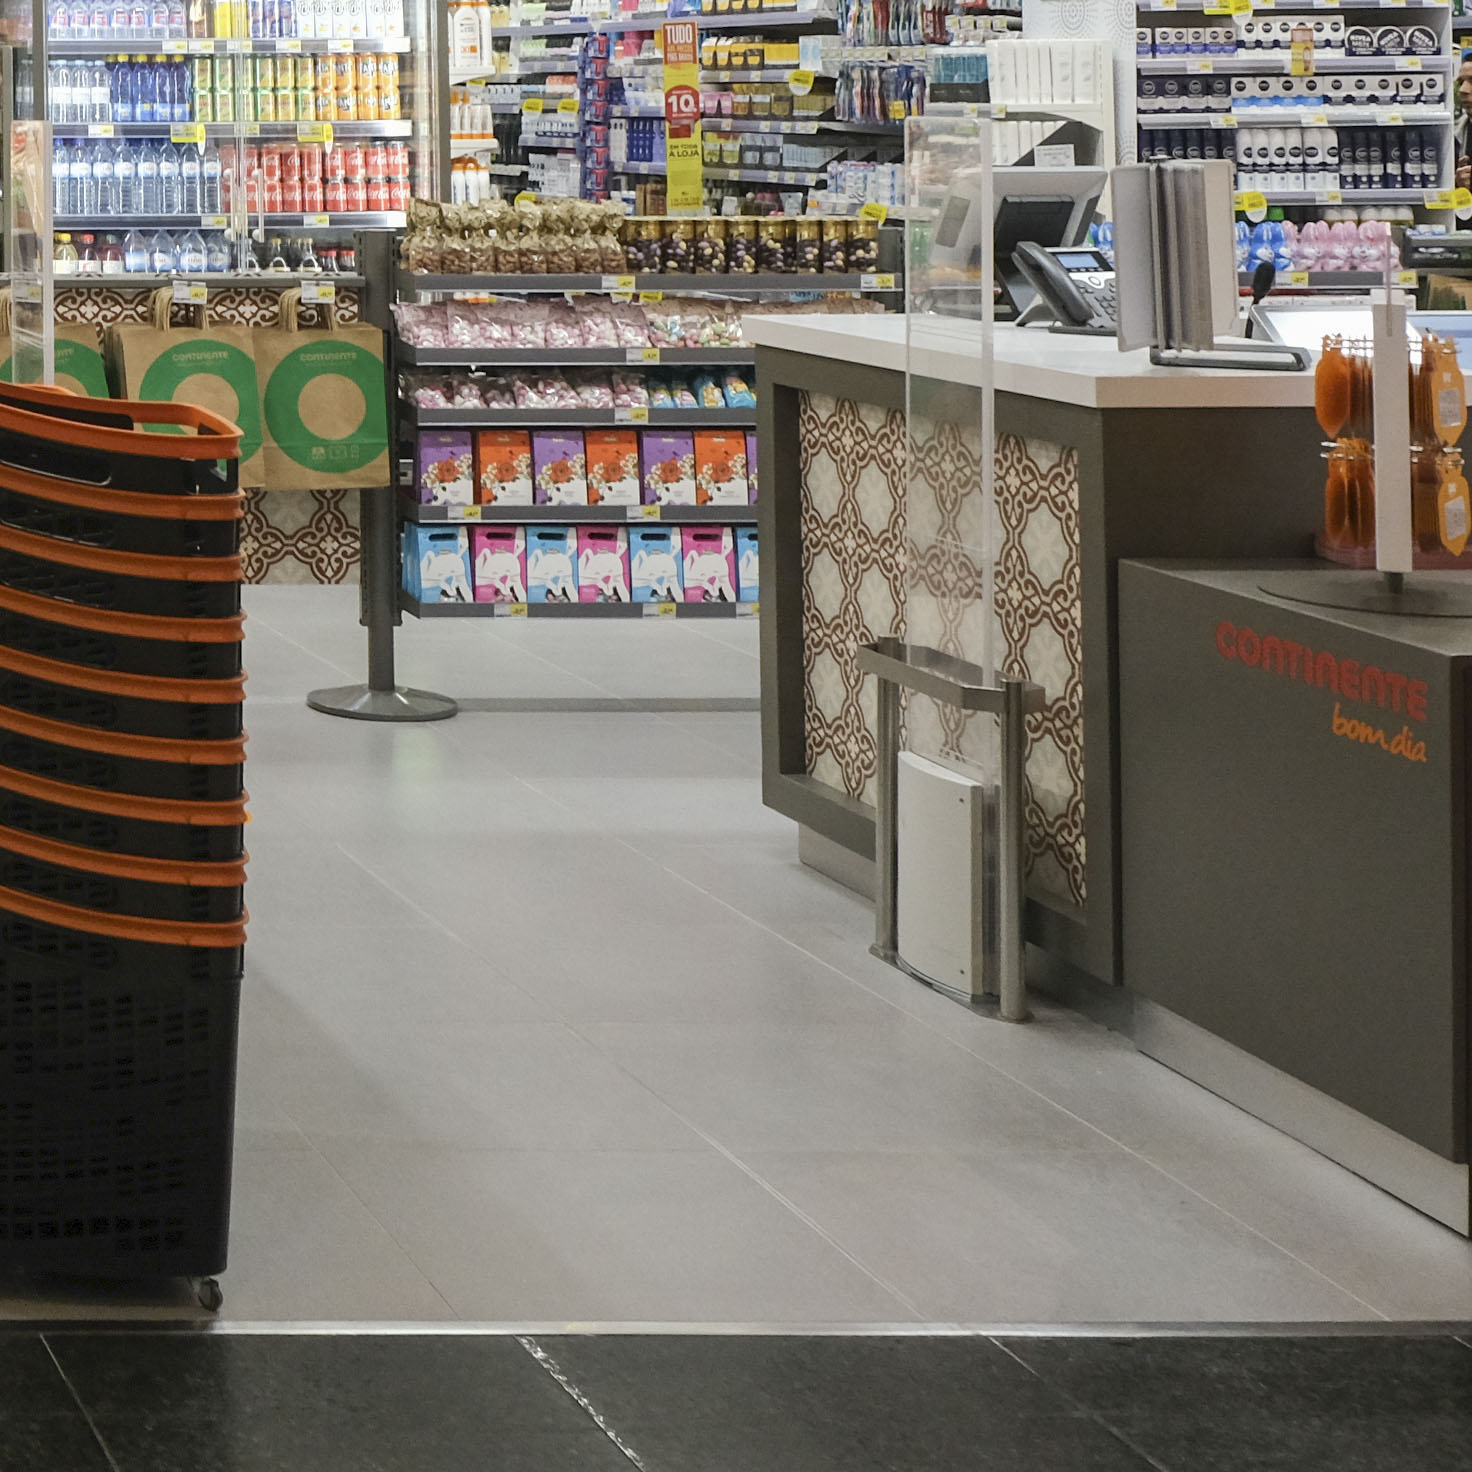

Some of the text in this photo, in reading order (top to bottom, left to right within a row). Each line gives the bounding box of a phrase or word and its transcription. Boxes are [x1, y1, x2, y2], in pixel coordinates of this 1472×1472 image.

[664, 23, 693, 44] TUDO
[678, 149, 699, 158] LOJA
[172, 350, 229, 363] CONTINENTE
[1215, 621, 1429, 723] CONTINENTE
[1331, 702, 1428, 764] bom dia
